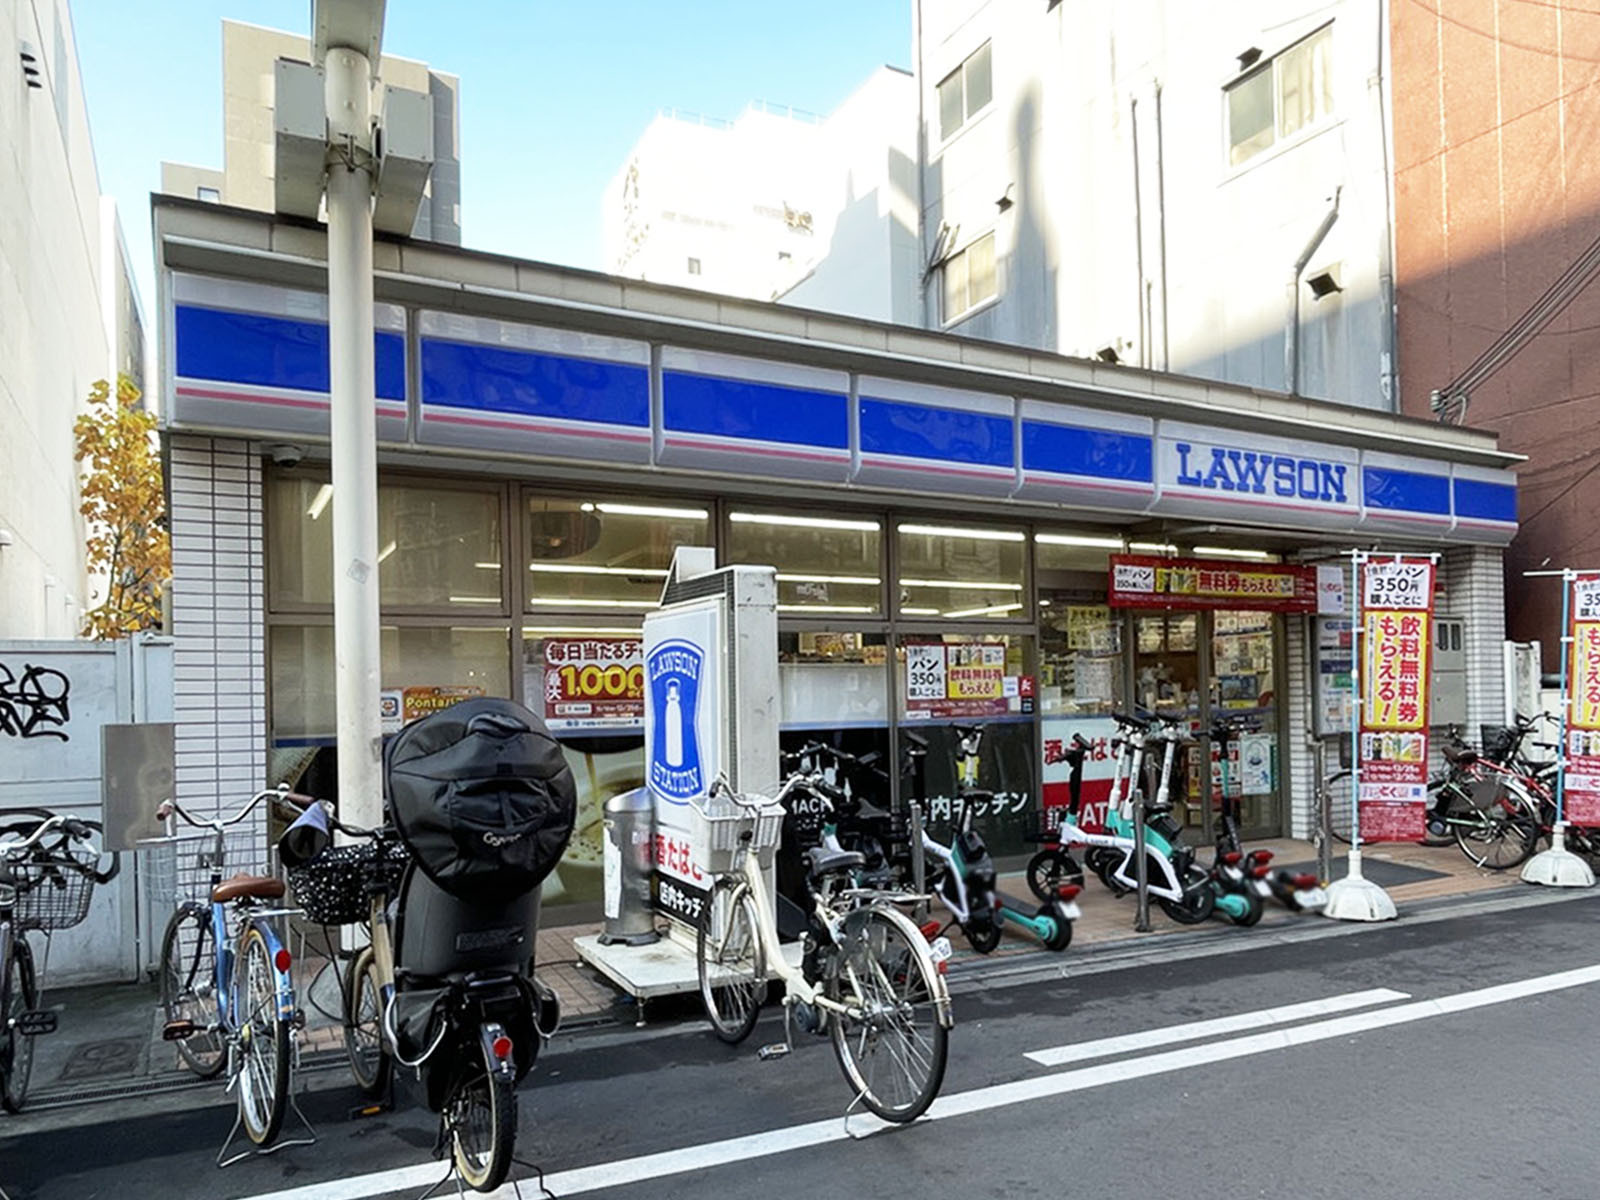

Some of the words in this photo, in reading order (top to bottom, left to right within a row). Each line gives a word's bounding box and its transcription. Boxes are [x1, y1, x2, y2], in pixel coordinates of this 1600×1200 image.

[1176, 443, 1347, 503] LAWSON
[651, 651, 698, 680] LAWSON
[1398, 616, 1421, 722] 飲料無料券
[652, 760, 699, 793] STATION
